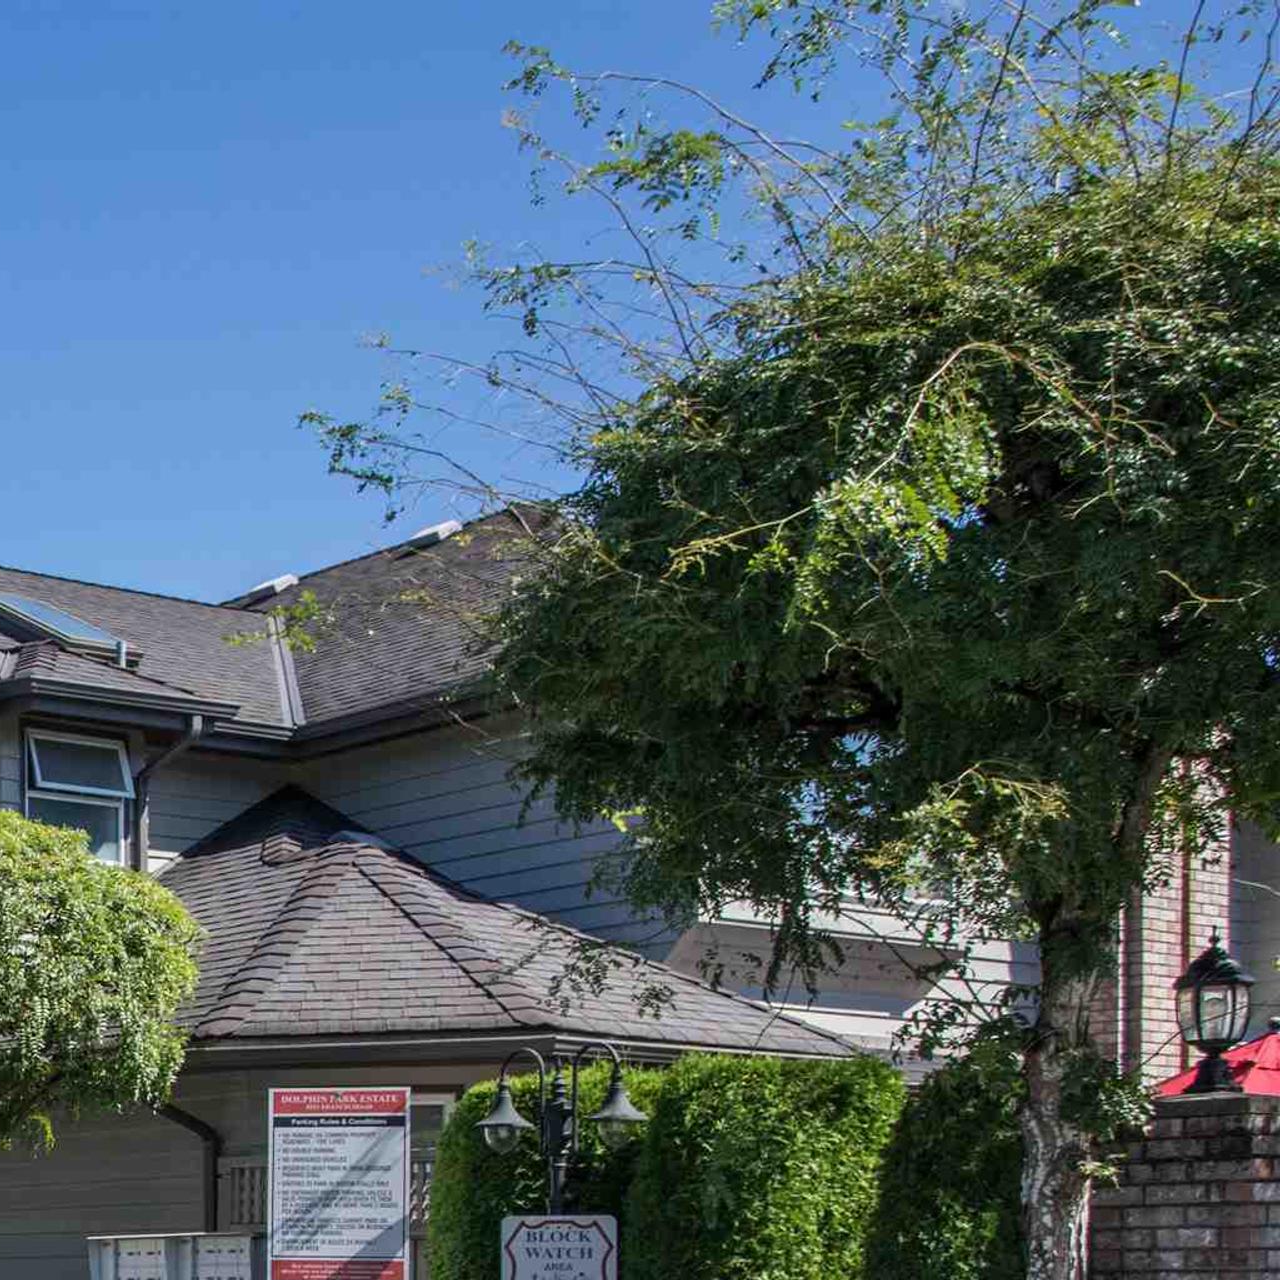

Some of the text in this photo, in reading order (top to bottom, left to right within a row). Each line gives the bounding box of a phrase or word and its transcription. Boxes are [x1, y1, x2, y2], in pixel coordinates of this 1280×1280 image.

[281, 1094, 400, 1103] DOLPHIN PARK ESTATE
[291, 1118, 318, 1126] Parking
[526, 1231, 591, 1242] BLOCK
[525, 1247, 593, 1259] WATCH
[544, 1263, 573, 1271] AREA
